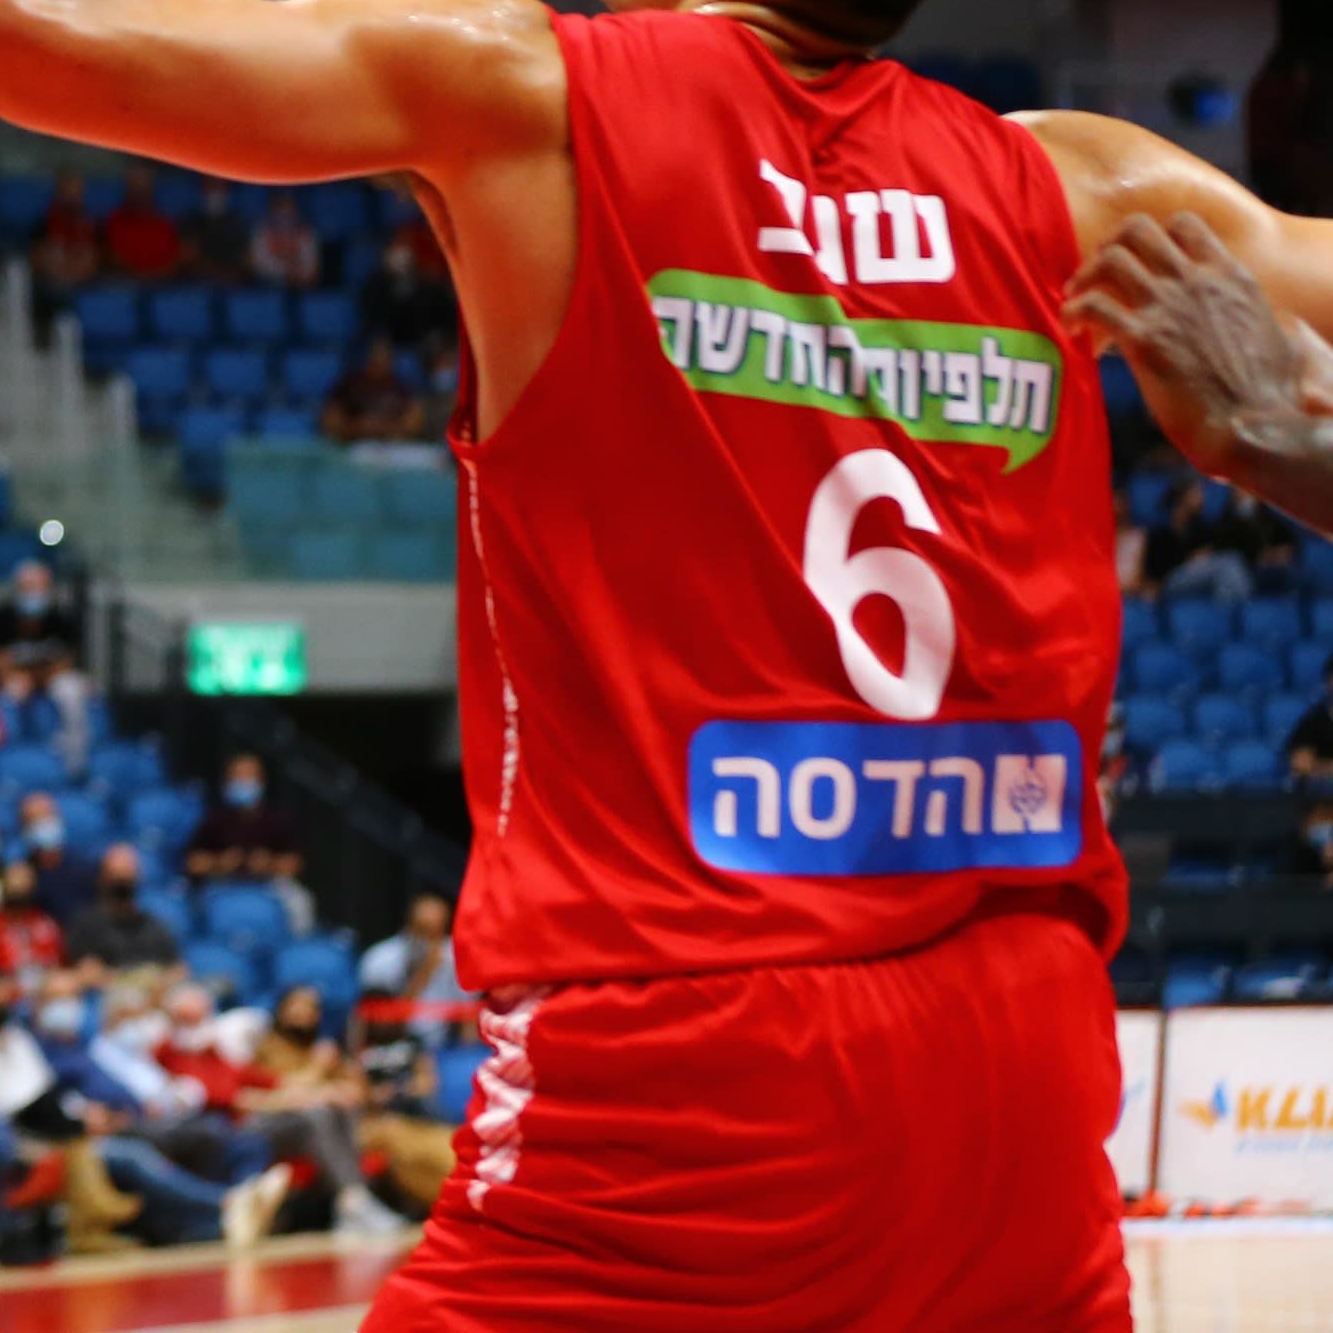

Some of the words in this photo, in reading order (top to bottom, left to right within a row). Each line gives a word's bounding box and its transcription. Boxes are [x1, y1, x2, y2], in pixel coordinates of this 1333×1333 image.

[803, 448, 956, 720] 6
[712, 756, 984, 840] הדסה
[1235, 1084, 1333, 1131] KLI
